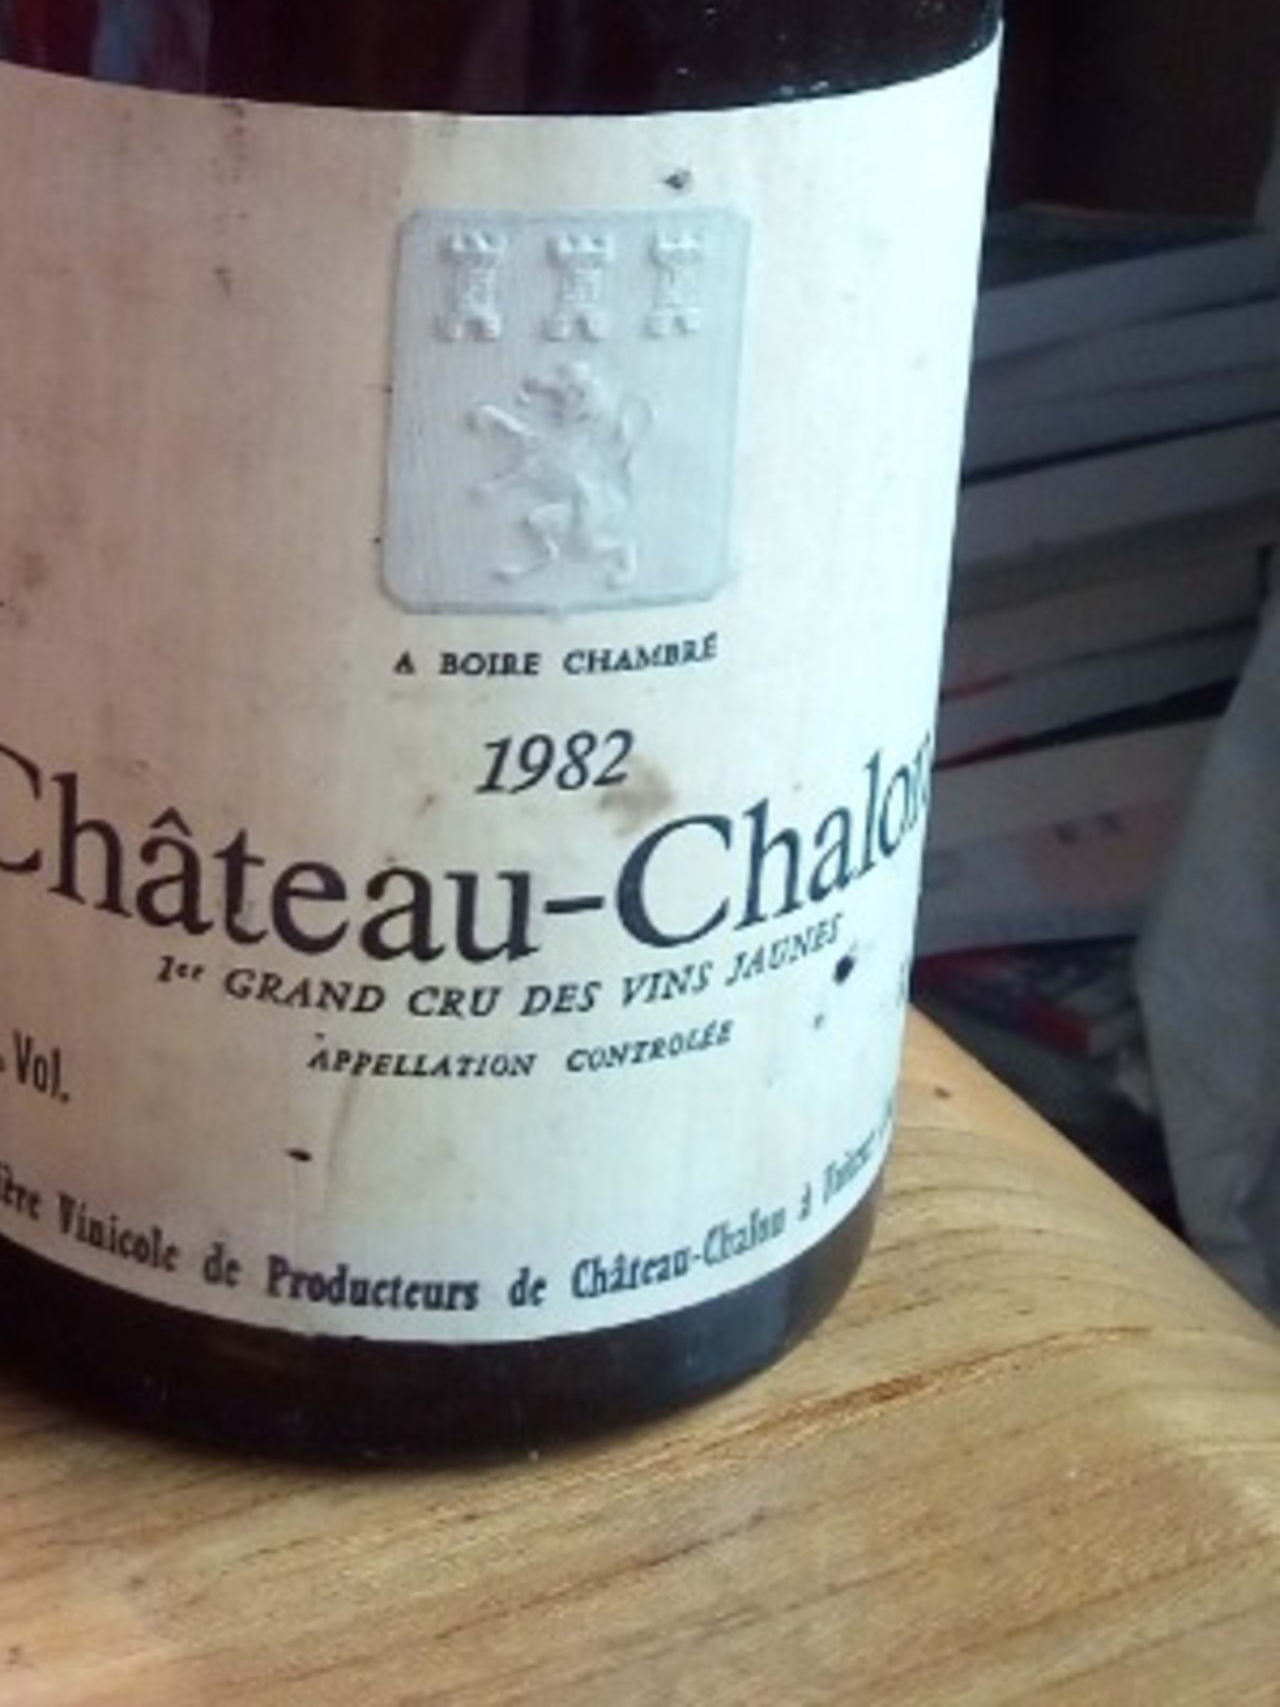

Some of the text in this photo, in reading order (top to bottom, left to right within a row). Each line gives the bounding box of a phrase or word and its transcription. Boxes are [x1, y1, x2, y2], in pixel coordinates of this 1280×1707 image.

[394, 631, 719, 677] A BOIRE CHAMBRÉ
[474, 728, 634, 796] 1982
[157, 955, 206, 984] 1er
[224, 967, 386, 1015] GRAND
[408, 986, 502, 1020] CRU
[520, 981, 603, 1019] DES
[621, 961, 716, 1010] VINS
[724, 911, 844, 988] JAUNES
[12, 1026, 71, 1105] Vol.
[306, 1047, 538, 1078] APPELLATION
[56, 1190, 182, 1273] Vinicole
[203, 1240, 242, 1287] de
[267, 1254, 480, 1312] Producteurs
[508, 1266, 548, 1308] de
[571, 1208, 788, 1301] Château-Chalon
